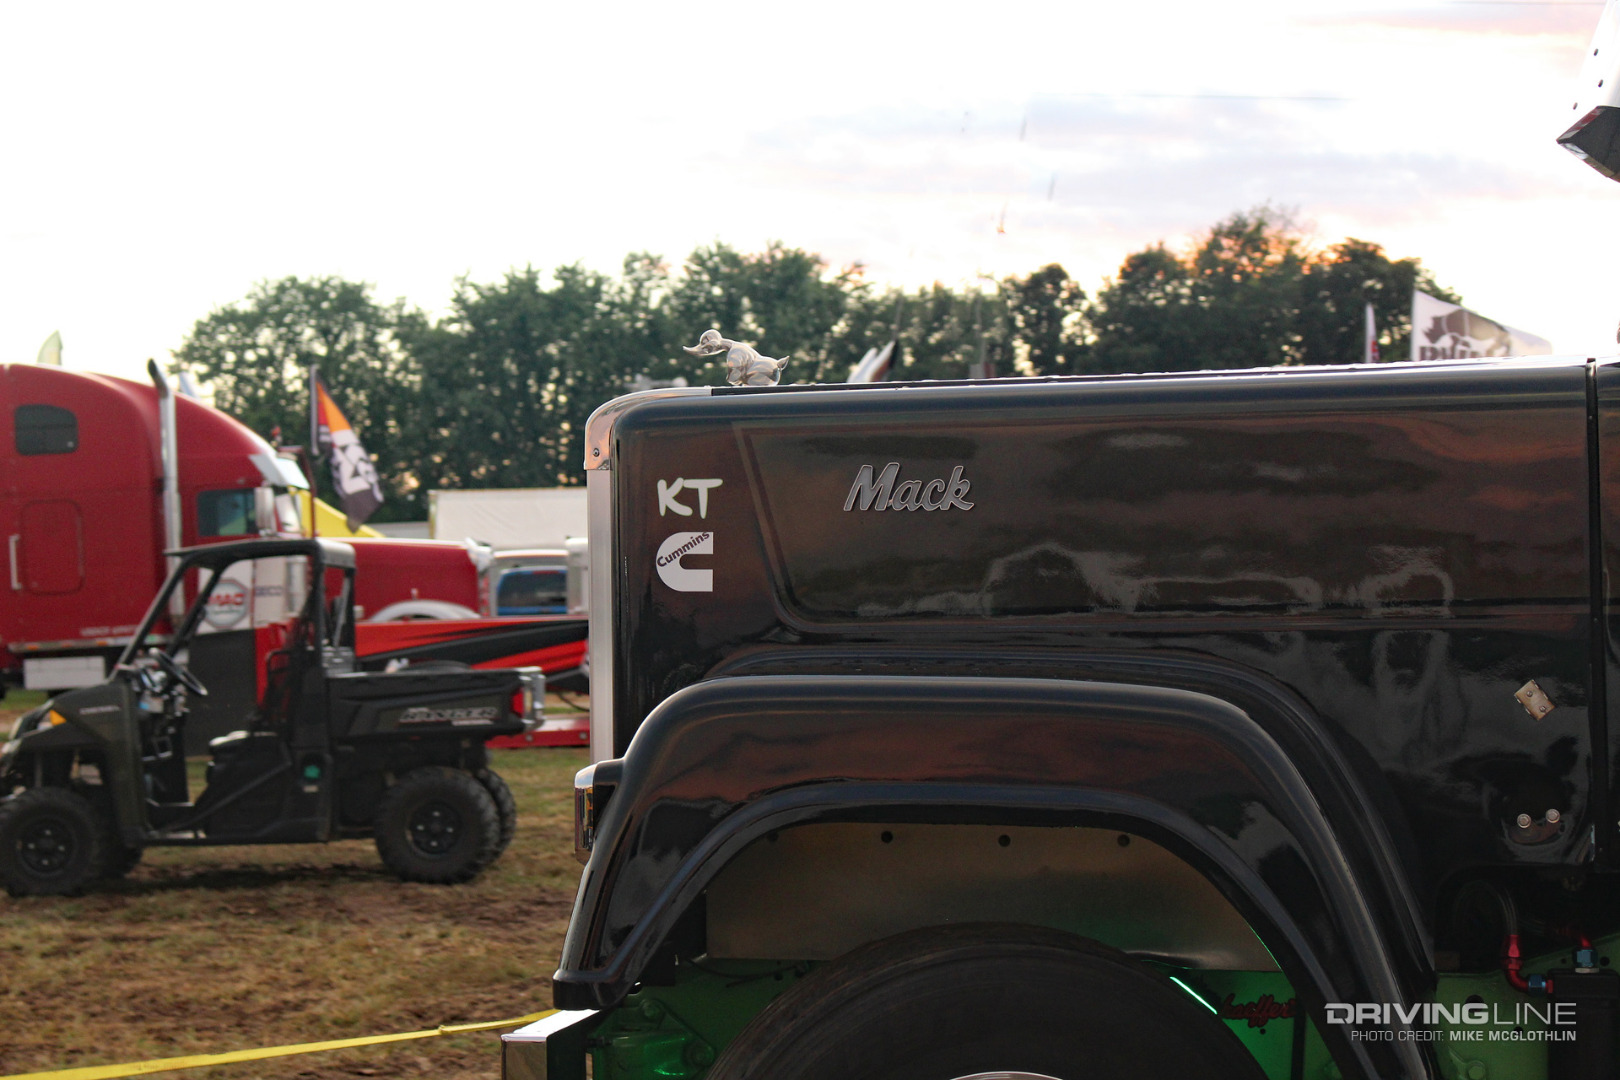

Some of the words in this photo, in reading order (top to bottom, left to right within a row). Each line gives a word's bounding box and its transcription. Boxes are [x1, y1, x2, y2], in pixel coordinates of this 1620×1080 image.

[657, 477, 724, 520] KT
[843, 462, 975, 512] Mack
[656, 531, 710, 568] Cummins
